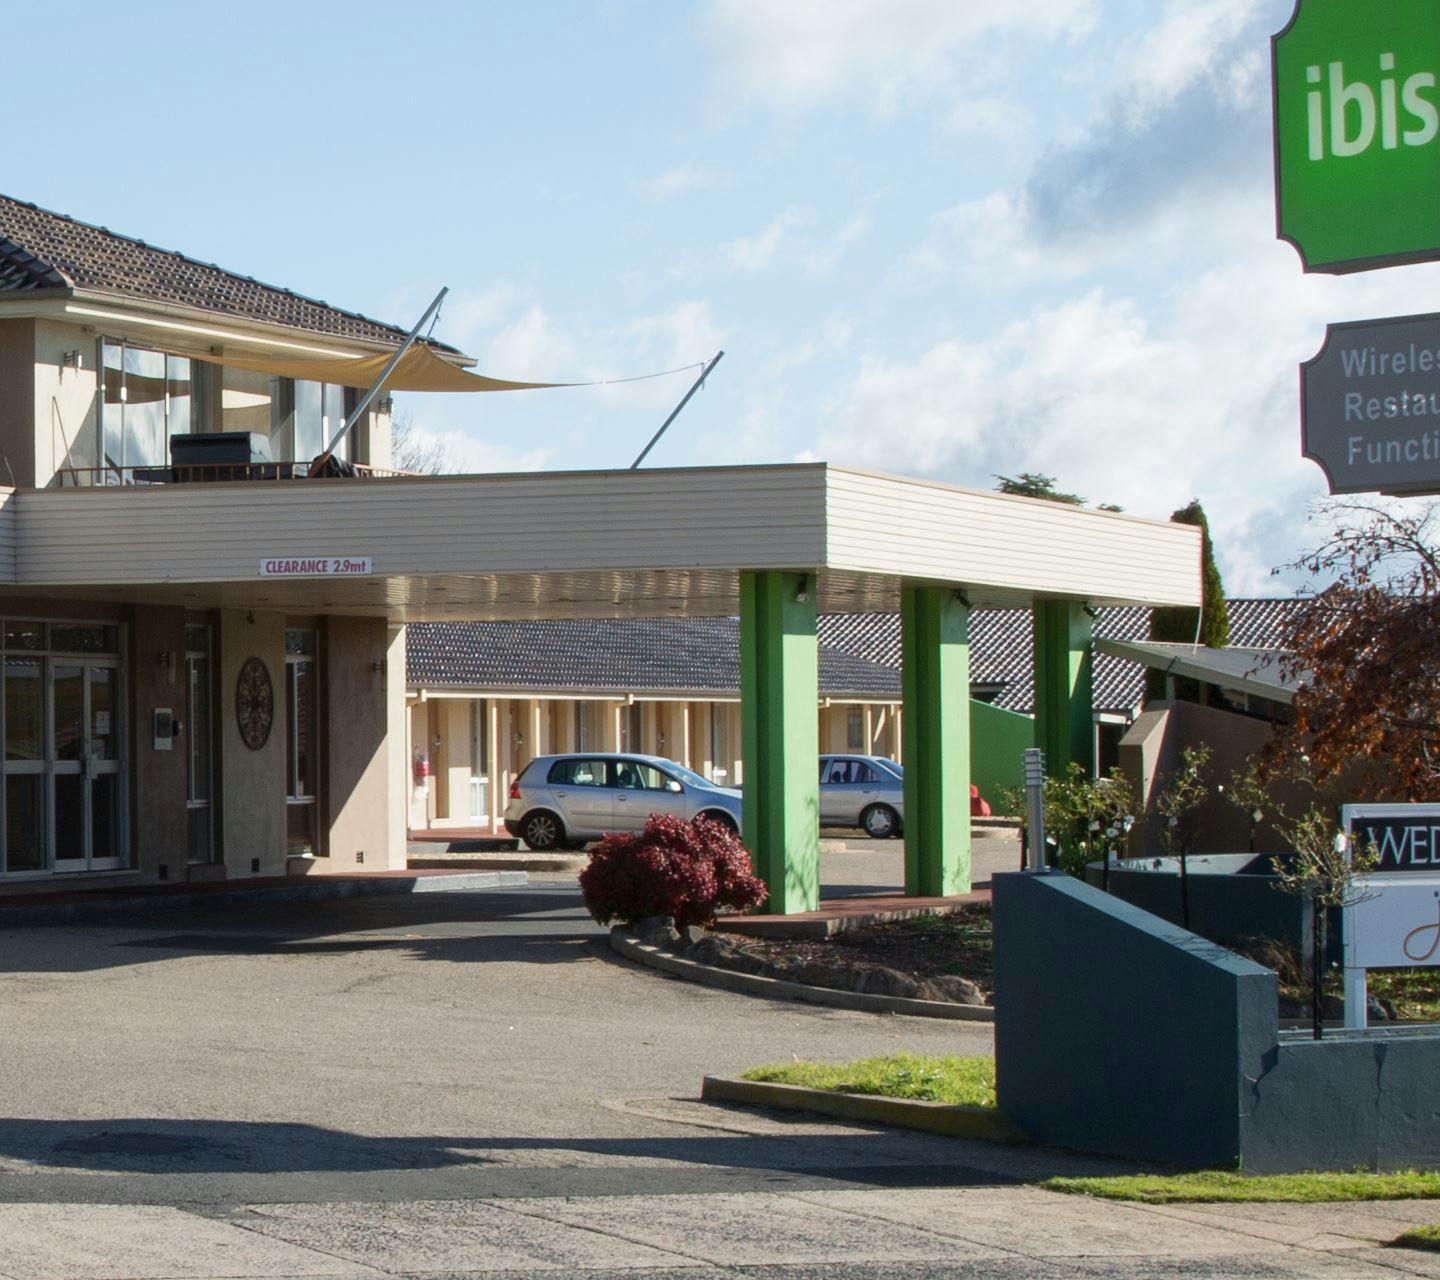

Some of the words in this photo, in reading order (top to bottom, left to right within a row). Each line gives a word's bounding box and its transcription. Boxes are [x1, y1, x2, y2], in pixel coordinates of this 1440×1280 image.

[1306, 52, 1440, 161] ibis
[265, 560, 328, 574] CLEARANCE
[333, 559, 366, 573] 2.9mt
